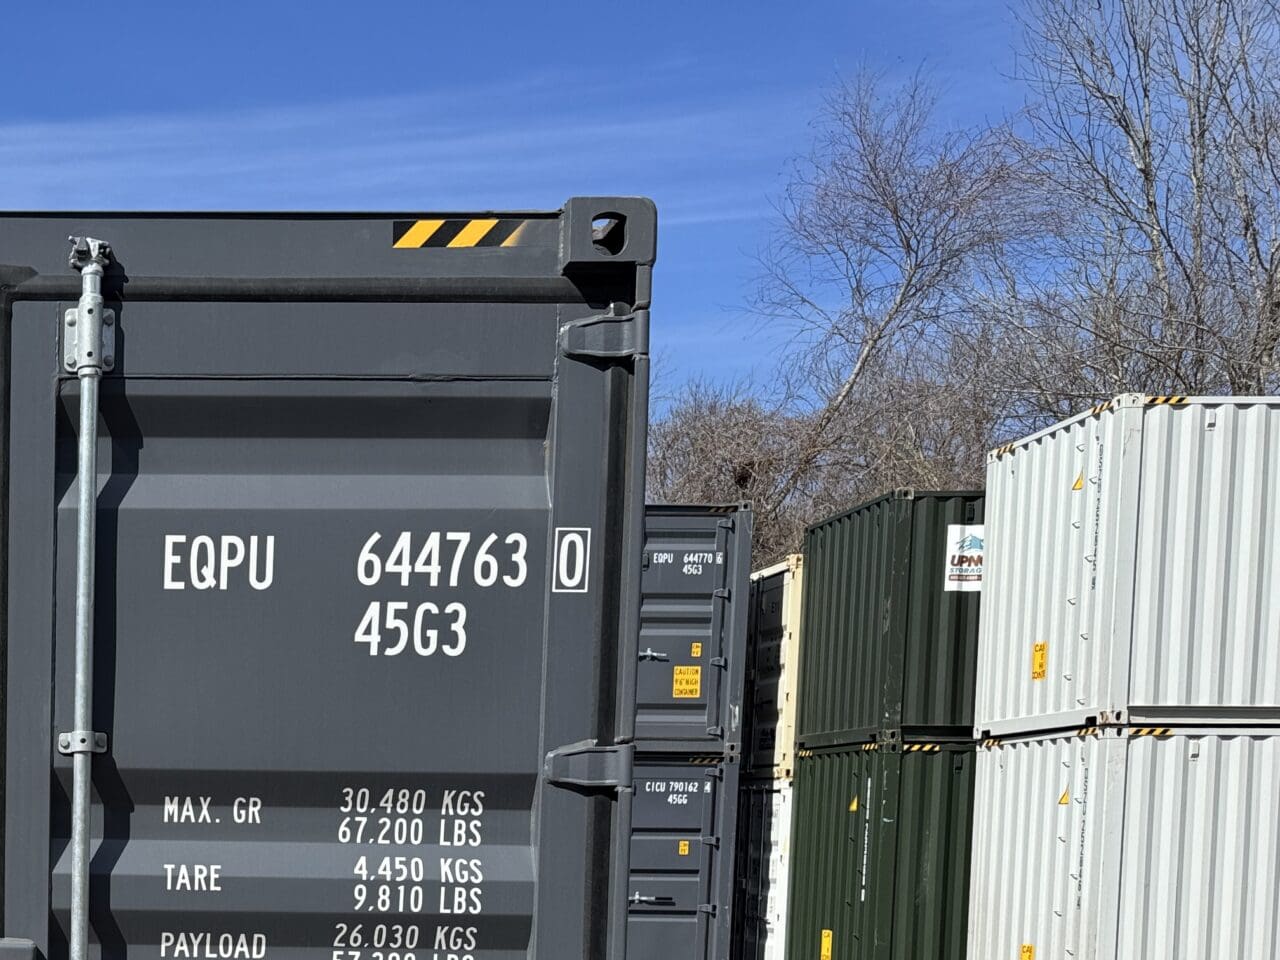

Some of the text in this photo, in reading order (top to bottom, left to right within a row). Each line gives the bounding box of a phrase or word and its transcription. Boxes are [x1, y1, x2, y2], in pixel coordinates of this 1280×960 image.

[163, 531, 586, 590] EQPU 644763 0
[653, 552, 674, 564] EQPU
[683, 552, 713, 564] 644770
[683, 564, 702, 575] 45G3
[354, 601, 467, 656] 45G3
[645, 781, 666, 792] CICU
[669, 781, 699, 793] 790162
[163, 796, 262, 825] MAX. GR
[340, 787, 485, 816] 30,480 KGS
[338, 816, 482, 847] 67,200 LBS
[163, 864, 222, 891] TARE
[353, 856, 484, 884] 4,450 KGS
[353, 884, 483, 914] 9,810 LBS
[160, 932, 267, 959] PAYLOAD
[333, 923, 478, 950] 26,030 KGS
